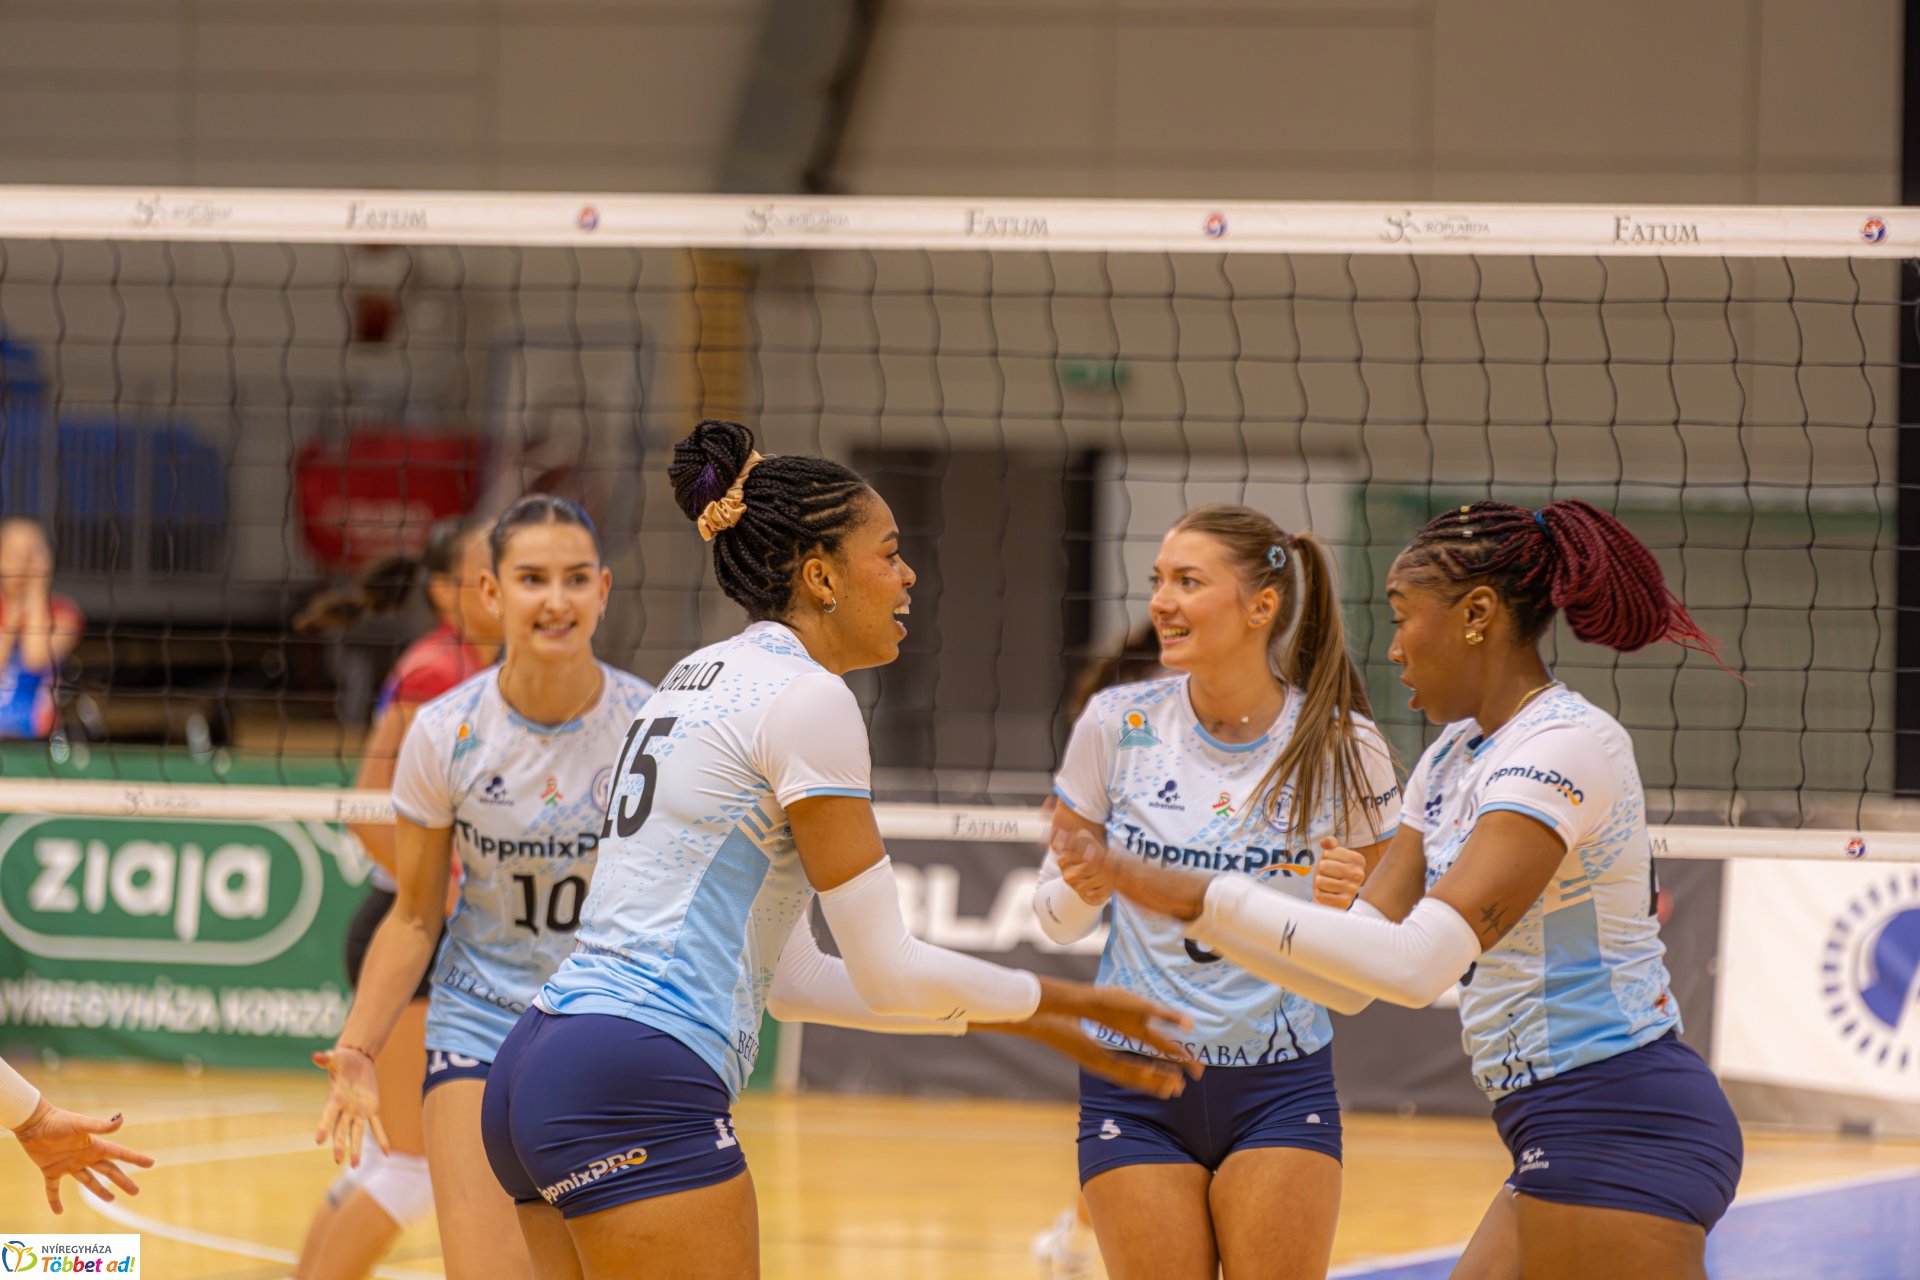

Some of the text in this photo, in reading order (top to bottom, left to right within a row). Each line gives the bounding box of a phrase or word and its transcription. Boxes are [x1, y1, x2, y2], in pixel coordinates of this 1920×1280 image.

[656, 661, 725, 692] URILLO
[600, 716, 678, 839] 15
[456, 819, 600, 862] TippmixP
[513, 873, 586, 936] 10
